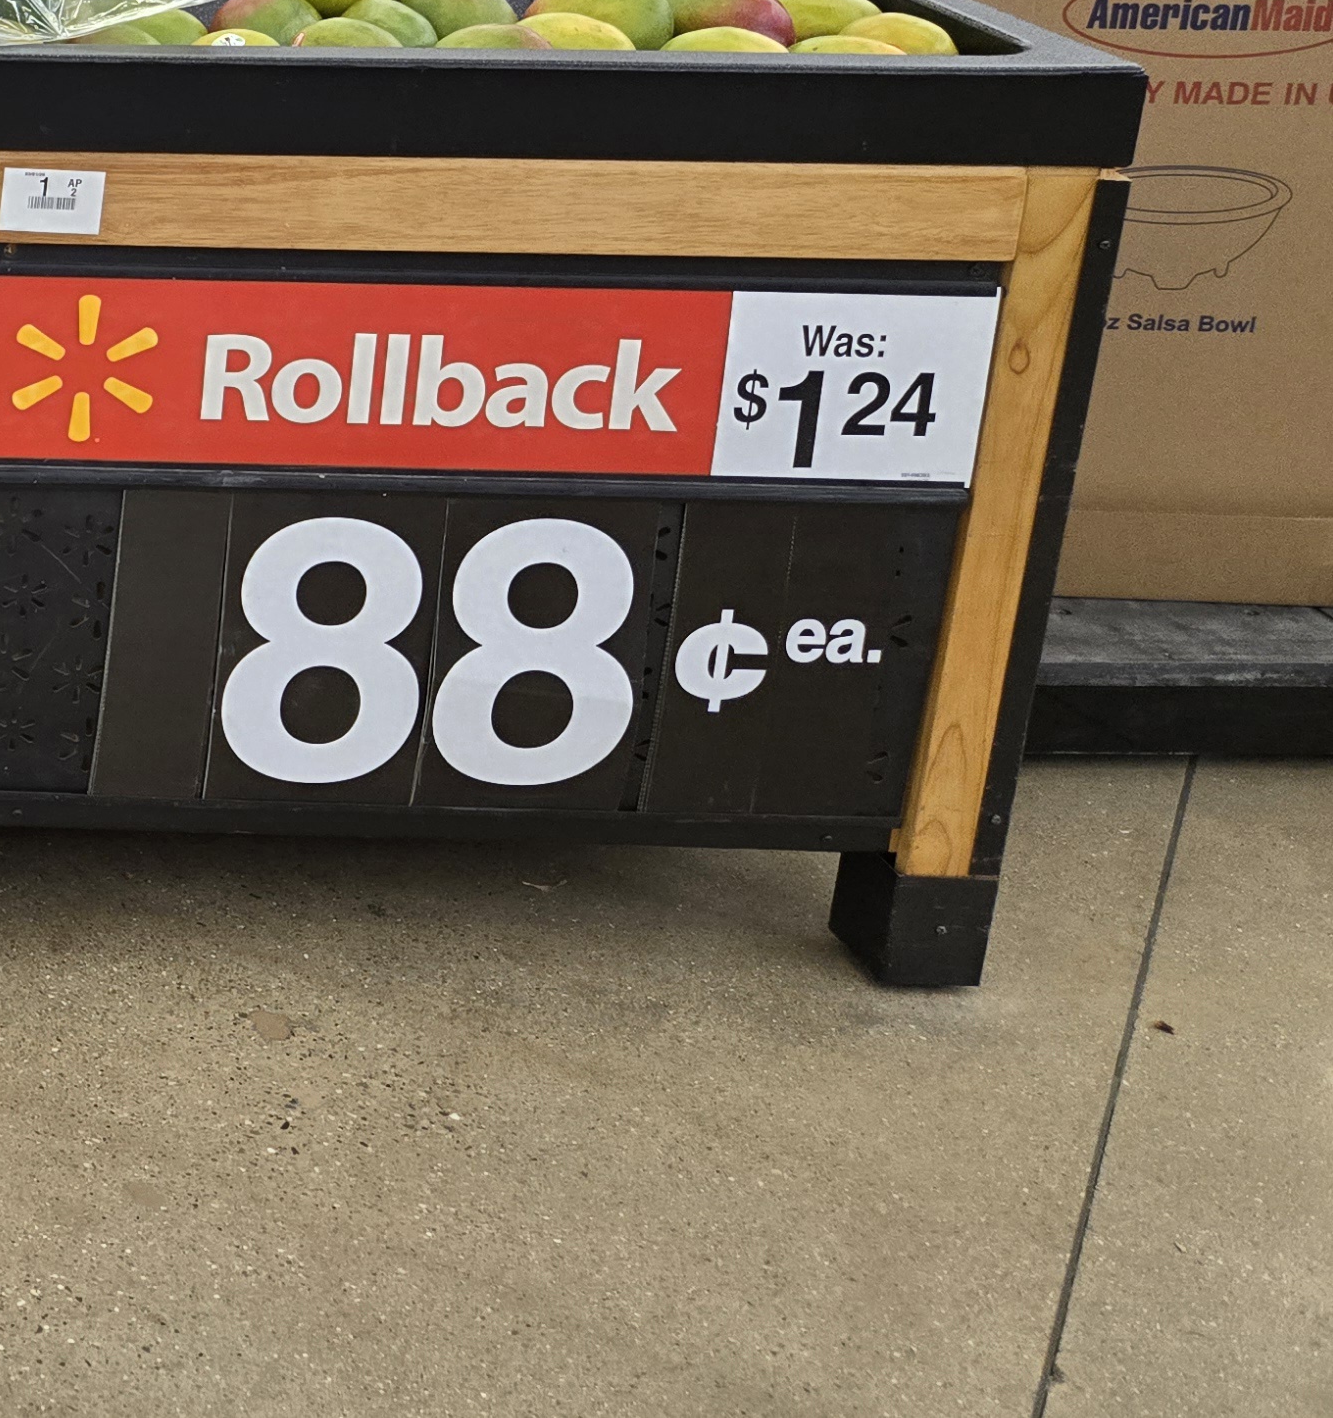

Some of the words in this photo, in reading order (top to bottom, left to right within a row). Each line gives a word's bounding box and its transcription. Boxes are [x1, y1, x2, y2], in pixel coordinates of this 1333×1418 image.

[1173, 81, 1273, 105] MADE
[1284, 82, 1318, 106] IN
[39, 176, 49, 197] 1
[67, 178, 83, 188] AP
[70, 187, 78, 197] 2
[1126, 313, 1190, 332] Salsa
[1197, 314, 1258, 334] Bowl
[802, 324, 888, 360] Was:
[199, 332, 682, 434] Rollback
[784, 617, 882, 669] ea.
